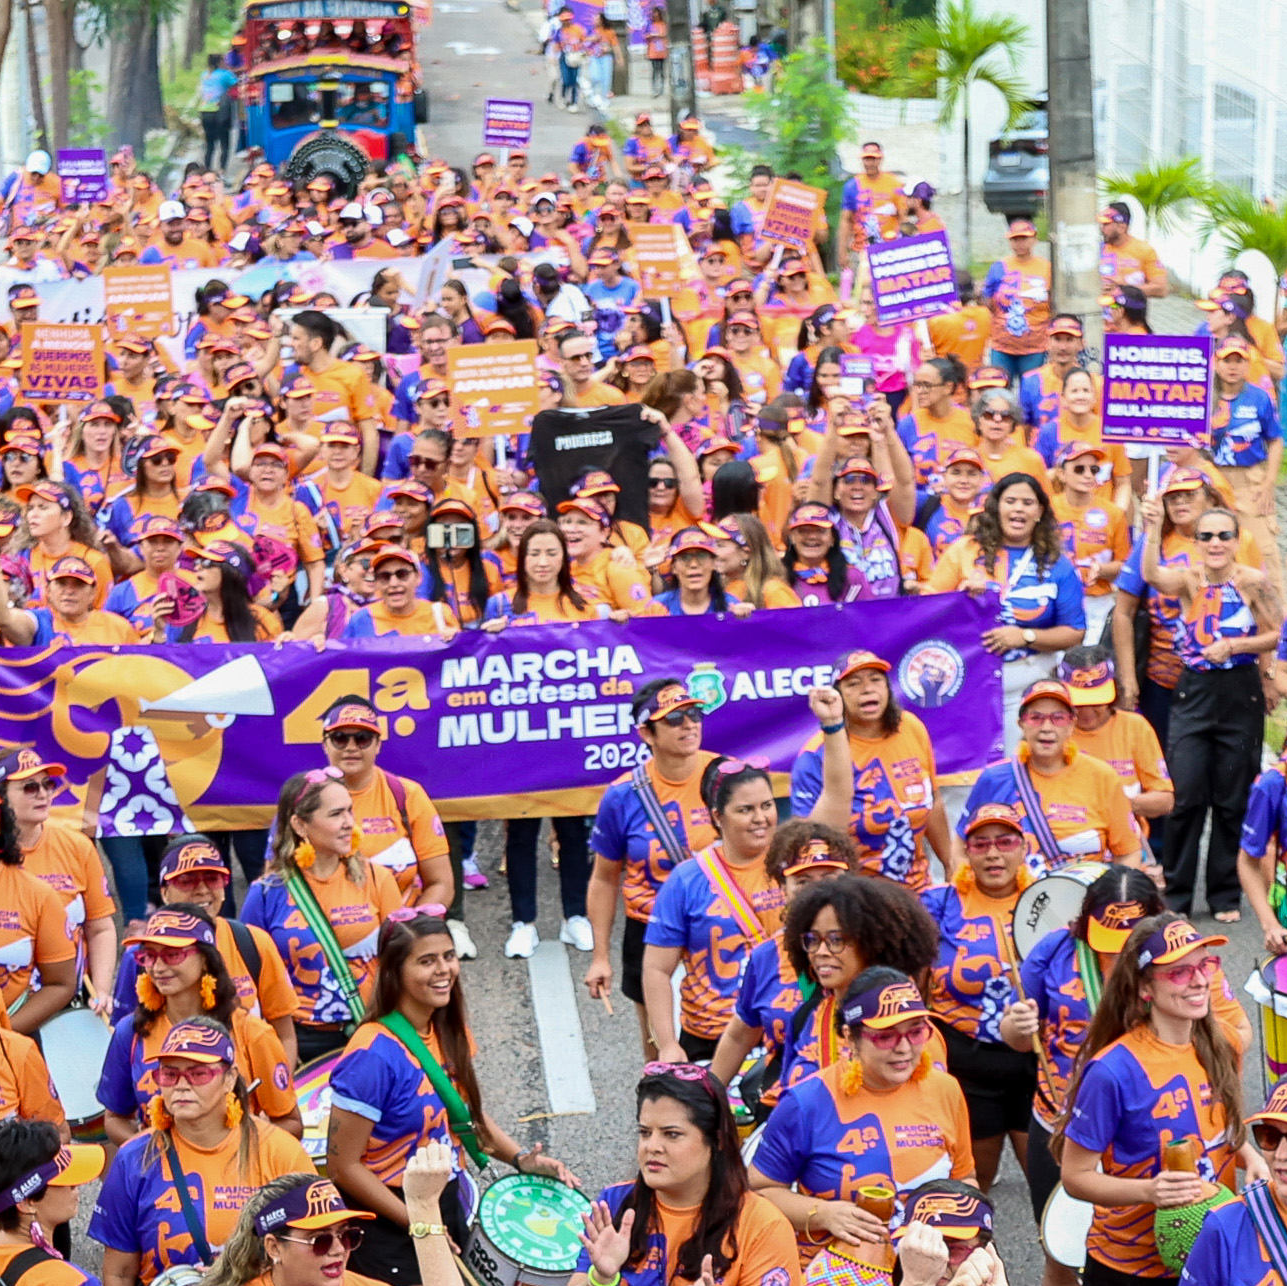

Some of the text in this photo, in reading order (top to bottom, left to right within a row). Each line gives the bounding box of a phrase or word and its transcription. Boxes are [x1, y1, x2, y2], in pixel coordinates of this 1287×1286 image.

[877, 266, 952, 294] MATAR
[1108, 345, 1208, 366] HOMENS,
[27, 374, 98, 389] VIVAS
[1108, 364, 1207, 382] PAREM DE
[1109, 382, 1206, 403] MATAR
[1107, 403, 1205, 419] MULHERES!
[440, 644, 643, 689] MARCHA
[446, 676, 633, 706] em defesa da
[730, 665, 834, 701] ALECE
[584, 742, 652, 769] 2026
[21, 1173, 43, 1194] ALECE
[494, 1175, 530, 1192] ONDE
[265, 1208, 286, 1227] ALECE
